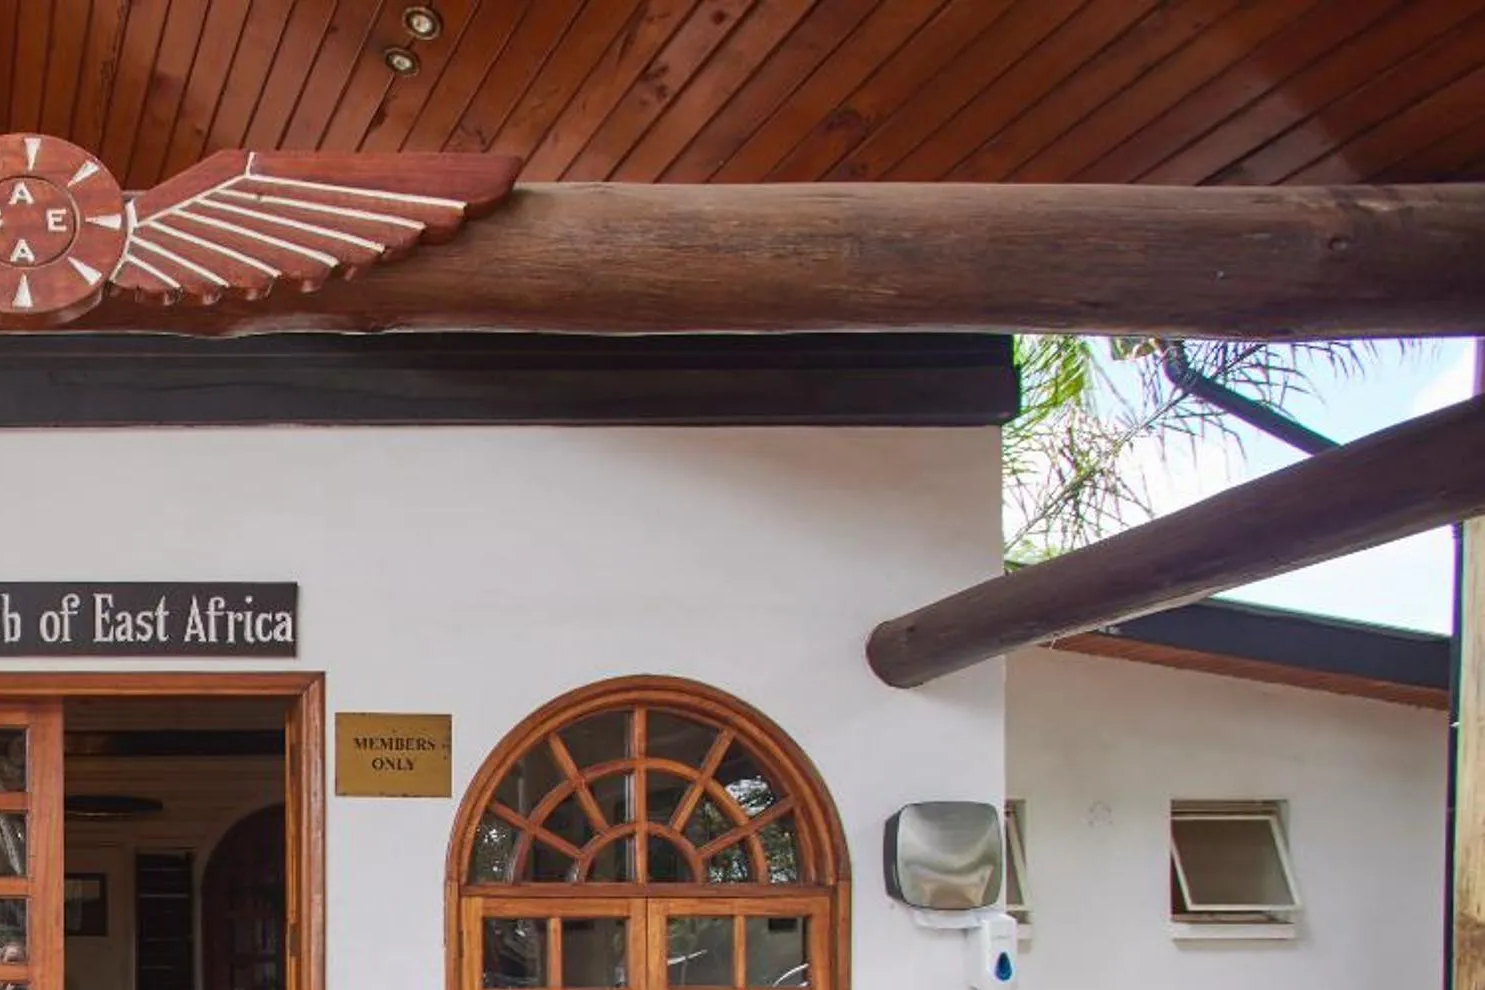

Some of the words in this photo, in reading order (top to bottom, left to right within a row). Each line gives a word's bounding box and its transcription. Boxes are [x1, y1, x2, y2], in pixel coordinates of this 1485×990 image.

[9, 181, 34, 205] A
[46, 209, 67, 232] E
[10, 238, 35, 262] A
[39, 593, 81, 642] of
[93, 593, 169, 642] East
[184, 595, 293, 643] Africa
[354, 737, 436, 751] MEMBERS
[371, 757, 414, 771] ONLY
